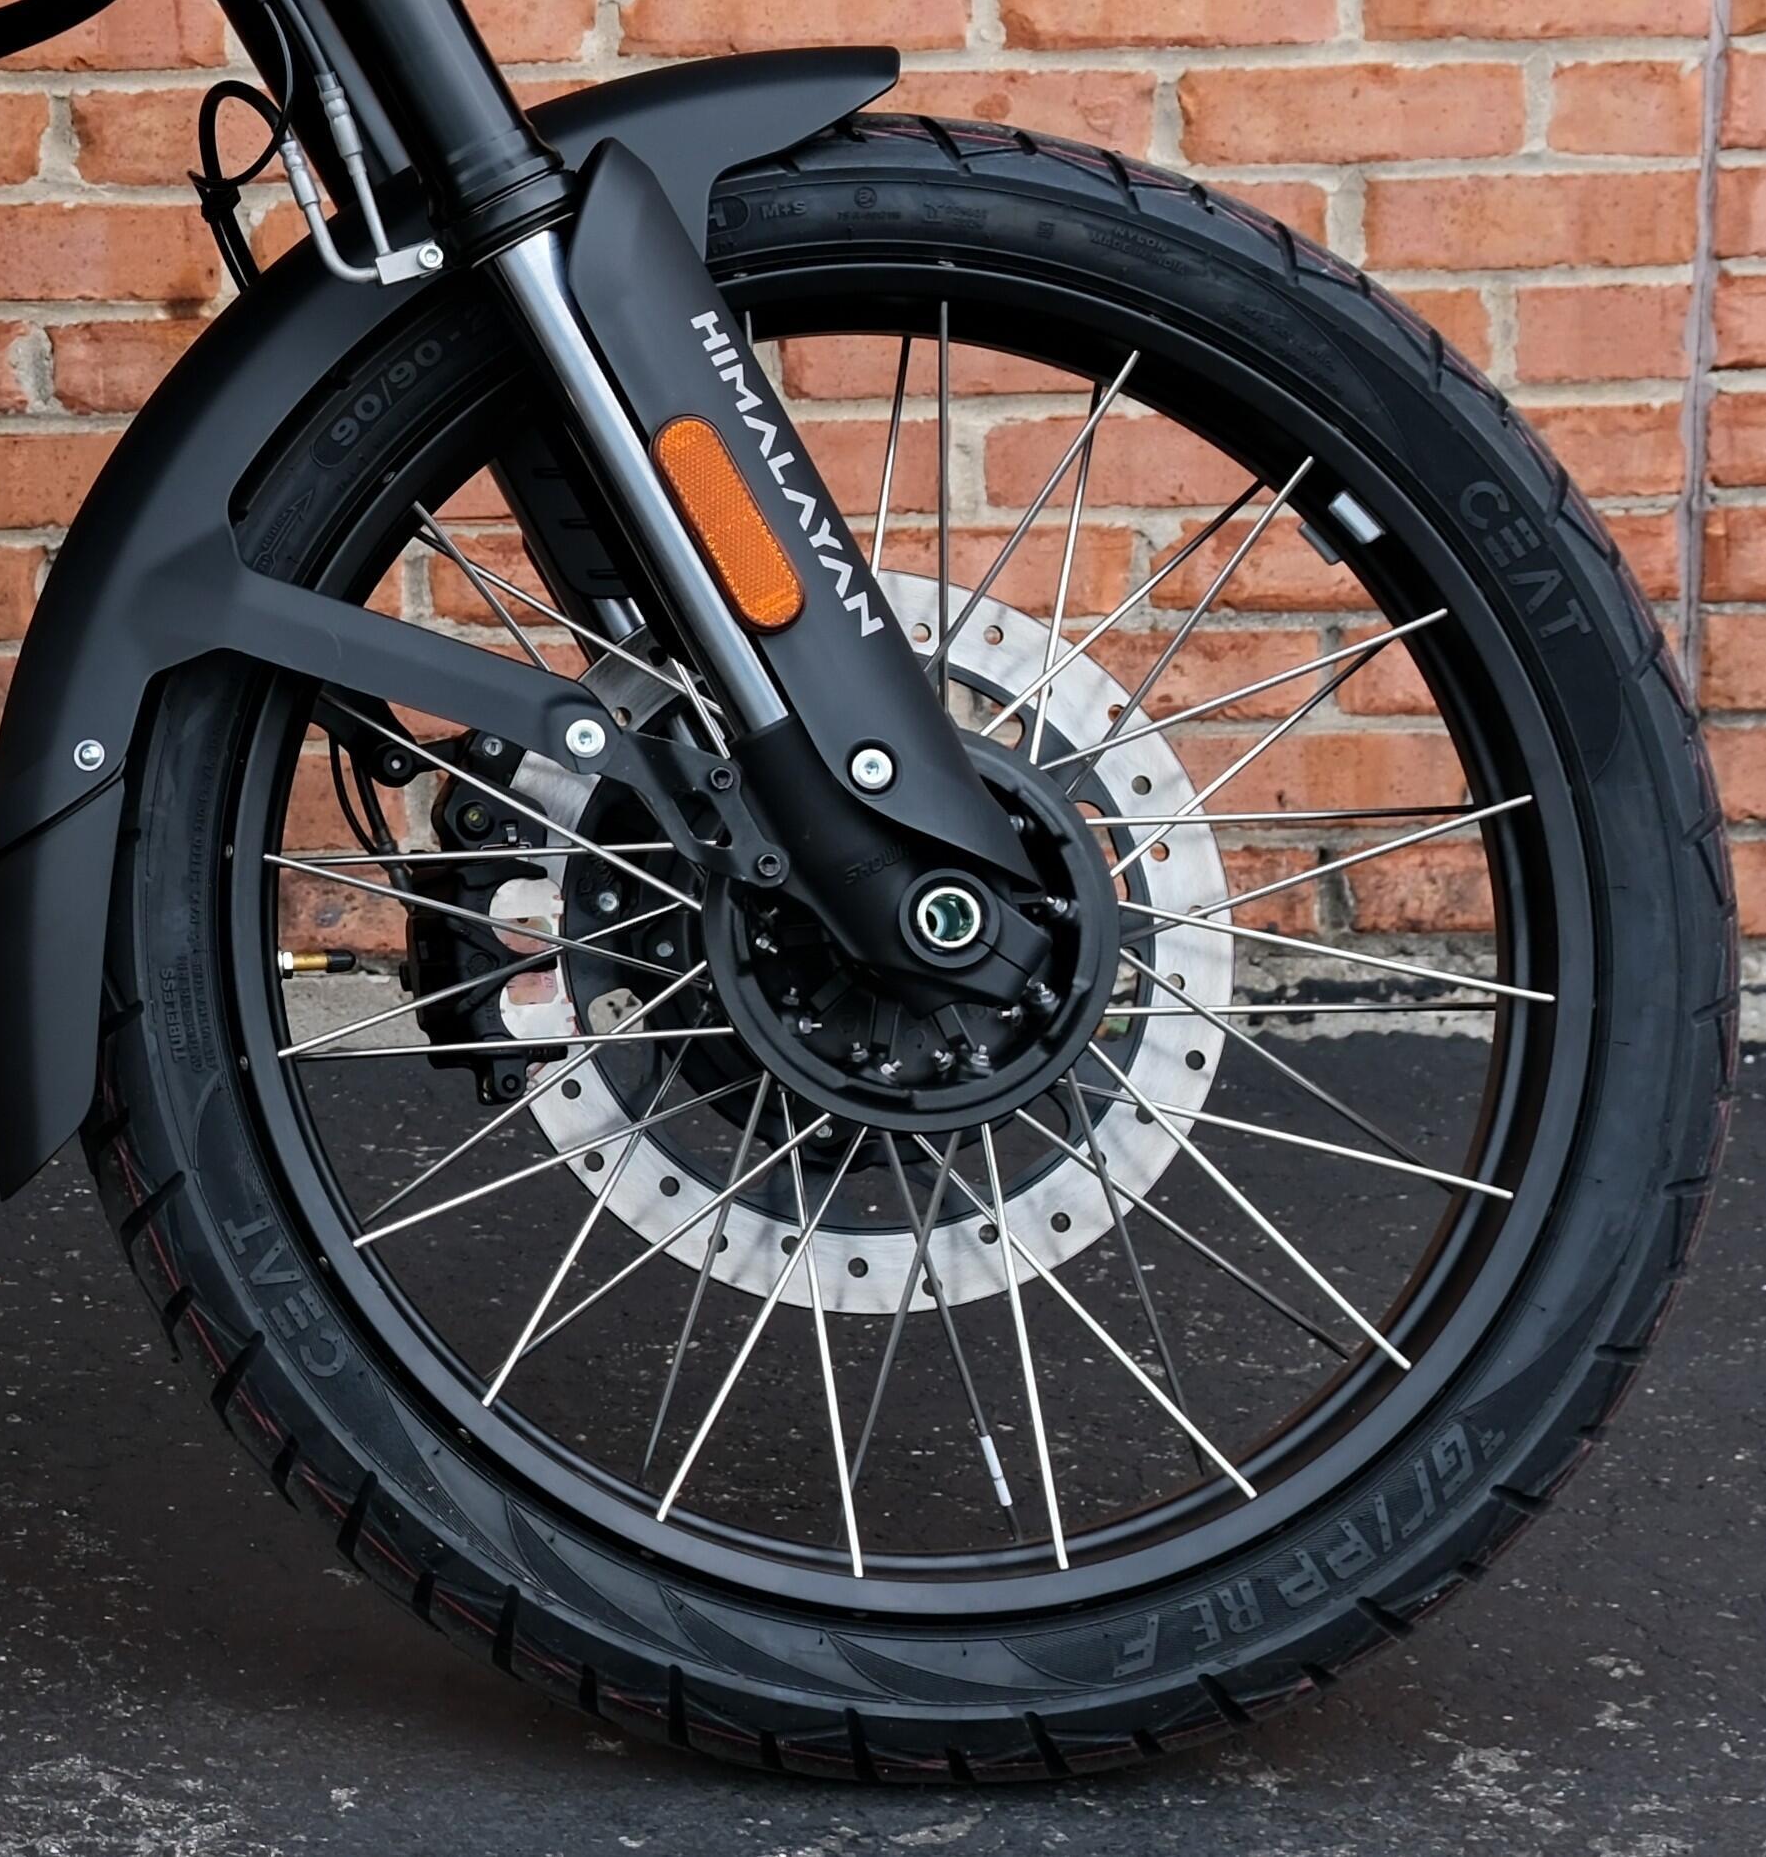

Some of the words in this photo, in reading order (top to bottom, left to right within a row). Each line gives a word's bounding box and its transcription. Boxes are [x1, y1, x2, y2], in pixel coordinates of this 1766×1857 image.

[690, 310, 885, 638] HIMALAYAN
[1459, 480, 1594, 641] CEAT
[160, 966, 188, 1064] TUBELESS
[222, 1215, 350, 1379] CEAT
[1111, 1613, 1160, 1680] F
[1193, 1579, 1266, 1649] RE
